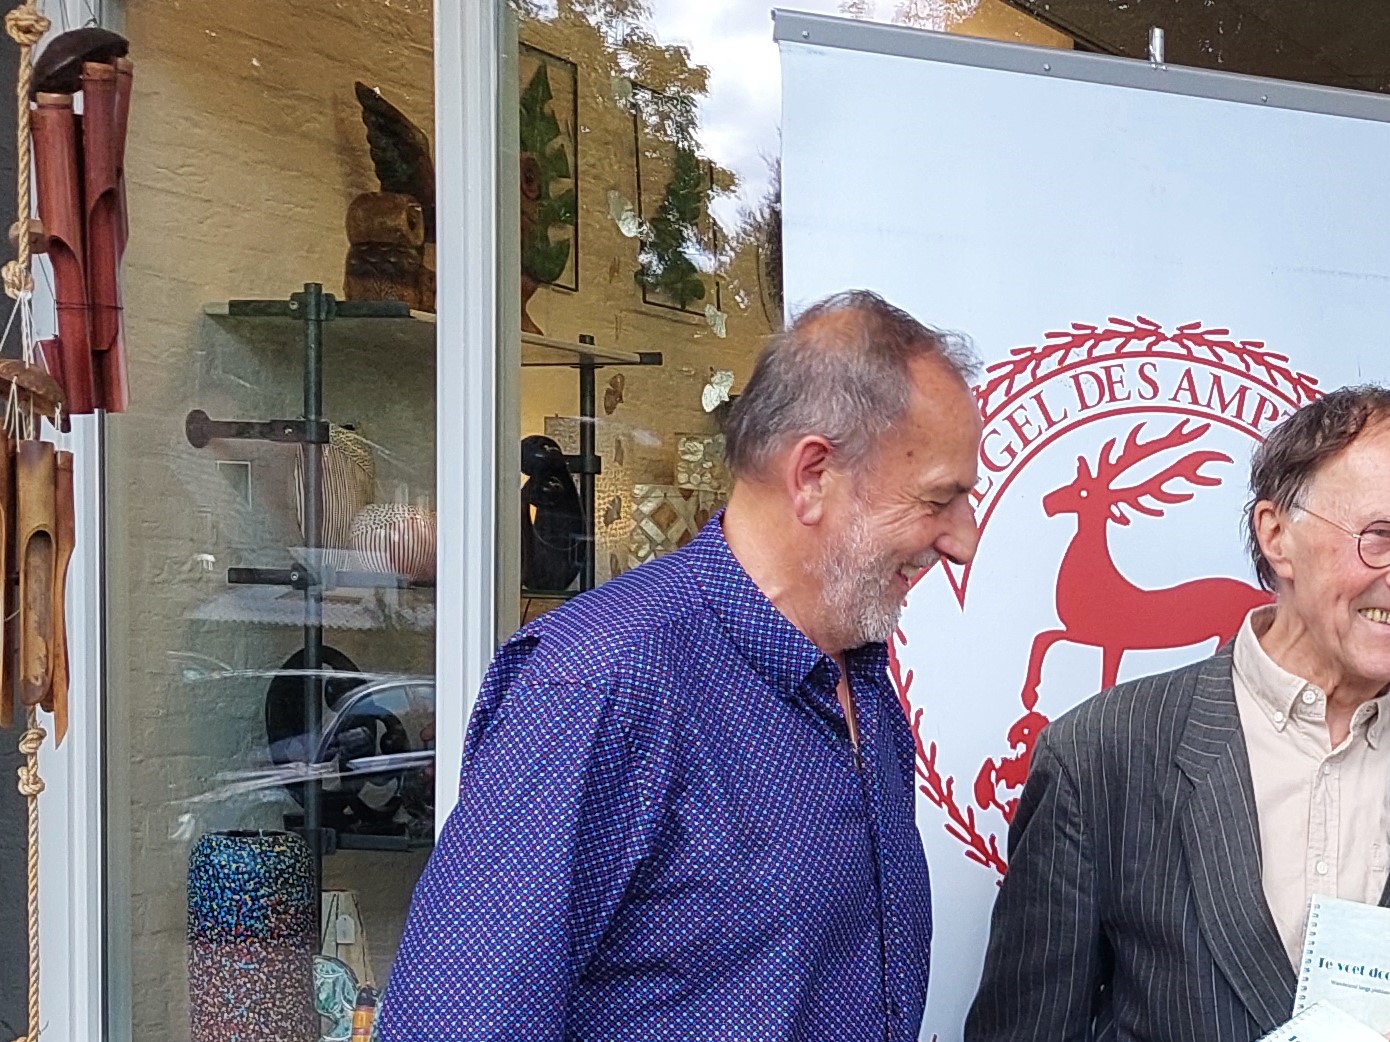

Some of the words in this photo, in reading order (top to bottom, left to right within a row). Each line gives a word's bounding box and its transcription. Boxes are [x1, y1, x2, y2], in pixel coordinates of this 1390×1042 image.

[1071, 362, 1160, 413] DES
[1168, 367, 1292, 431] AMP
[1318, 957, 1333, 970] Te
[1337, 962, 1365, 976] voet
